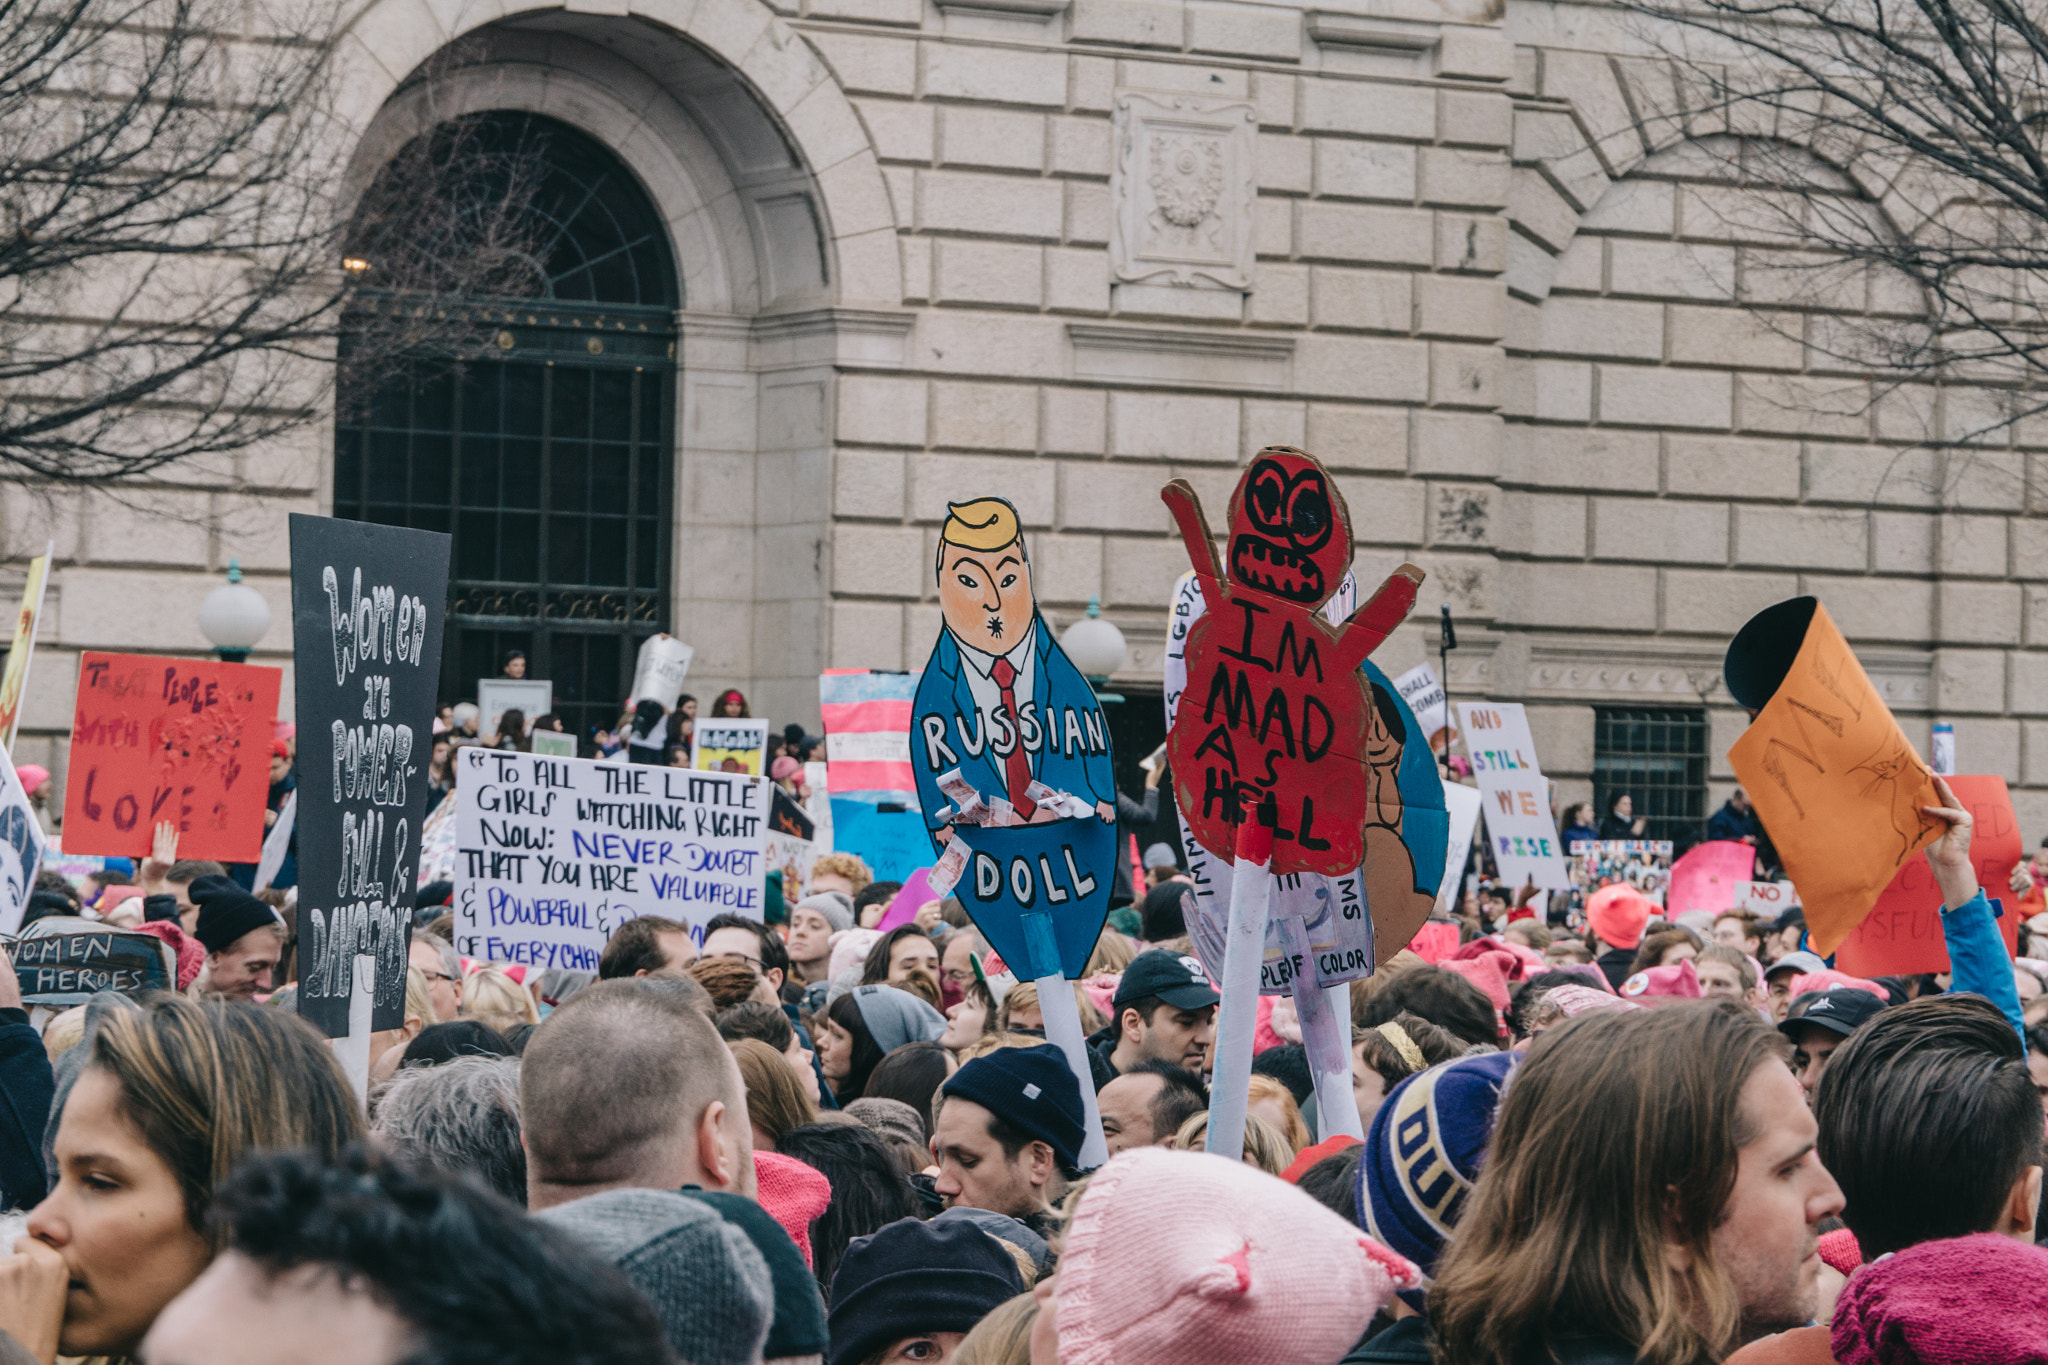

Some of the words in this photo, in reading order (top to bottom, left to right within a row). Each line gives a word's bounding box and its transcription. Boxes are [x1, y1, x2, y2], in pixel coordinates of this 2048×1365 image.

[322, 565, 427, 687] Women
[163, 666, 218, 714] PEOPLE
[362, 674, 391, 720] are
[1400, 672, 1433, 698] SHALL
[920, 701, 1107, 771] RUSSIAN
[1203, 660, 1335, 764] MAD
[1470, 709, 1502, 730] AND
[1473, 748, 1530, 771] STILL
[82, 765, 196, 833] LOVE
[533, 759, 576, 789] ALL
[594, 766, 651, 795] THE
[664, 772, 757, 810] LITTLE
[1202, 766, 1331, 851] HELL
[1495, 790, 1538, 816] WE
[477, 784, 557, 817] GIRLS
[577, 798, 687, 832] WATCHING
[694, 806, 761, 838] RIGHT
[337, 808, 385, 899] FULL
[390, 817, 410, 908] &
[572, 829, 682, 867] NEVER
[683, 842, 760, 877] DOUBT
[1499, 837, 1552, 858] RISE
[459, 848, 530, 884] THAT
[537, 855, 581, 888] YOU
[589, 863, 639, 893] ARE
[650, 872, 758, 909] VALUABLE
[974, 846, 1098, 907] DOLL
[461, 881, 476, 928] &
[488, 886, 594, 930] POWERFUL
[457, 935, 482, 956] OF
[1320, 948, 1368, 976] COLOR
[37, 968, 143, 992] HEROES
[1397, 1104, 1470, 1230] DU
